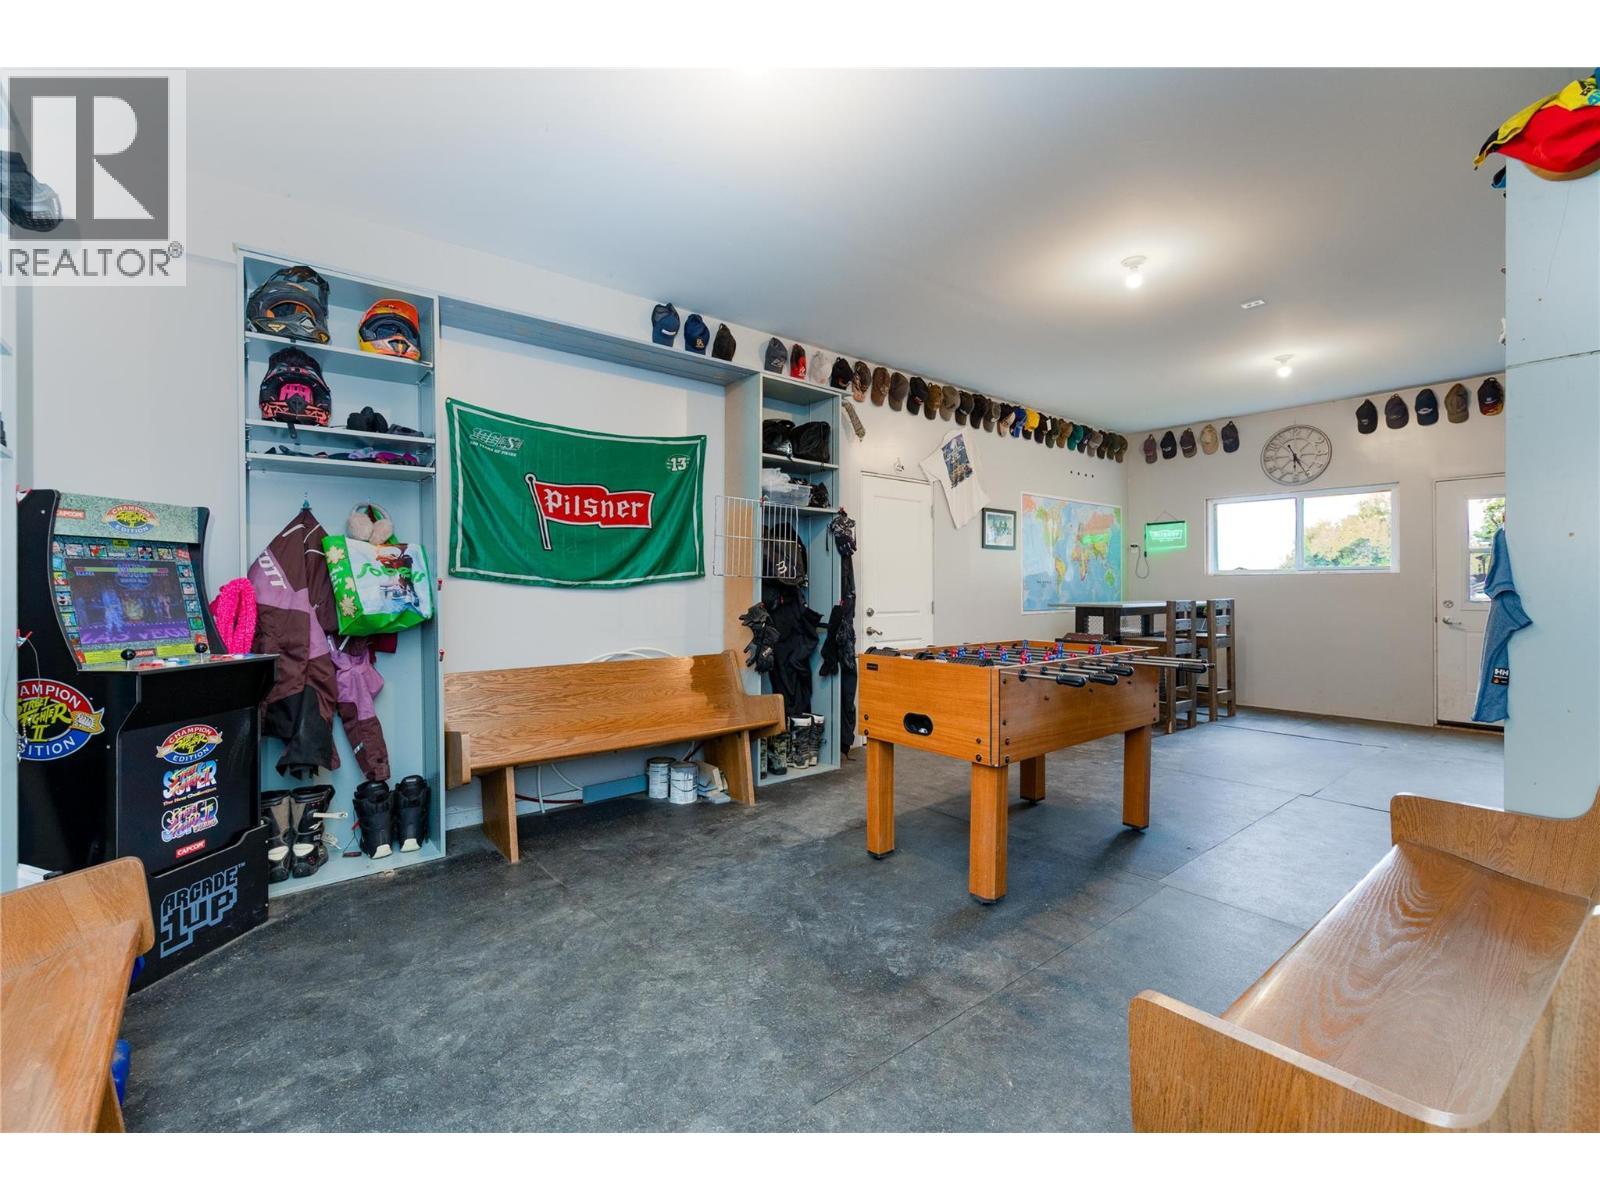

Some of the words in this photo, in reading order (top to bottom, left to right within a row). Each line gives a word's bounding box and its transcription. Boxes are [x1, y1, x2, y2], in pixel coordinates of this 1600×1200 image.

[670, 457, 687, 471] 13
[544, 488, 645, 519] Pilsner
[111, 505, 151, 518] CHAMPION
[115, 523, 150, 533] EDITION
[258, 550, 288, 590] OTT
[1494, 668, 1509, 676] HH
[169, 726, 212, 744] CHAMPION
[172, 747, 210, 762] EDITION
[176, 842, 205, 857] CAPCOM
[160, 865, 239, 919] ARCADE
[160, 886, 238, 959] 1UP
